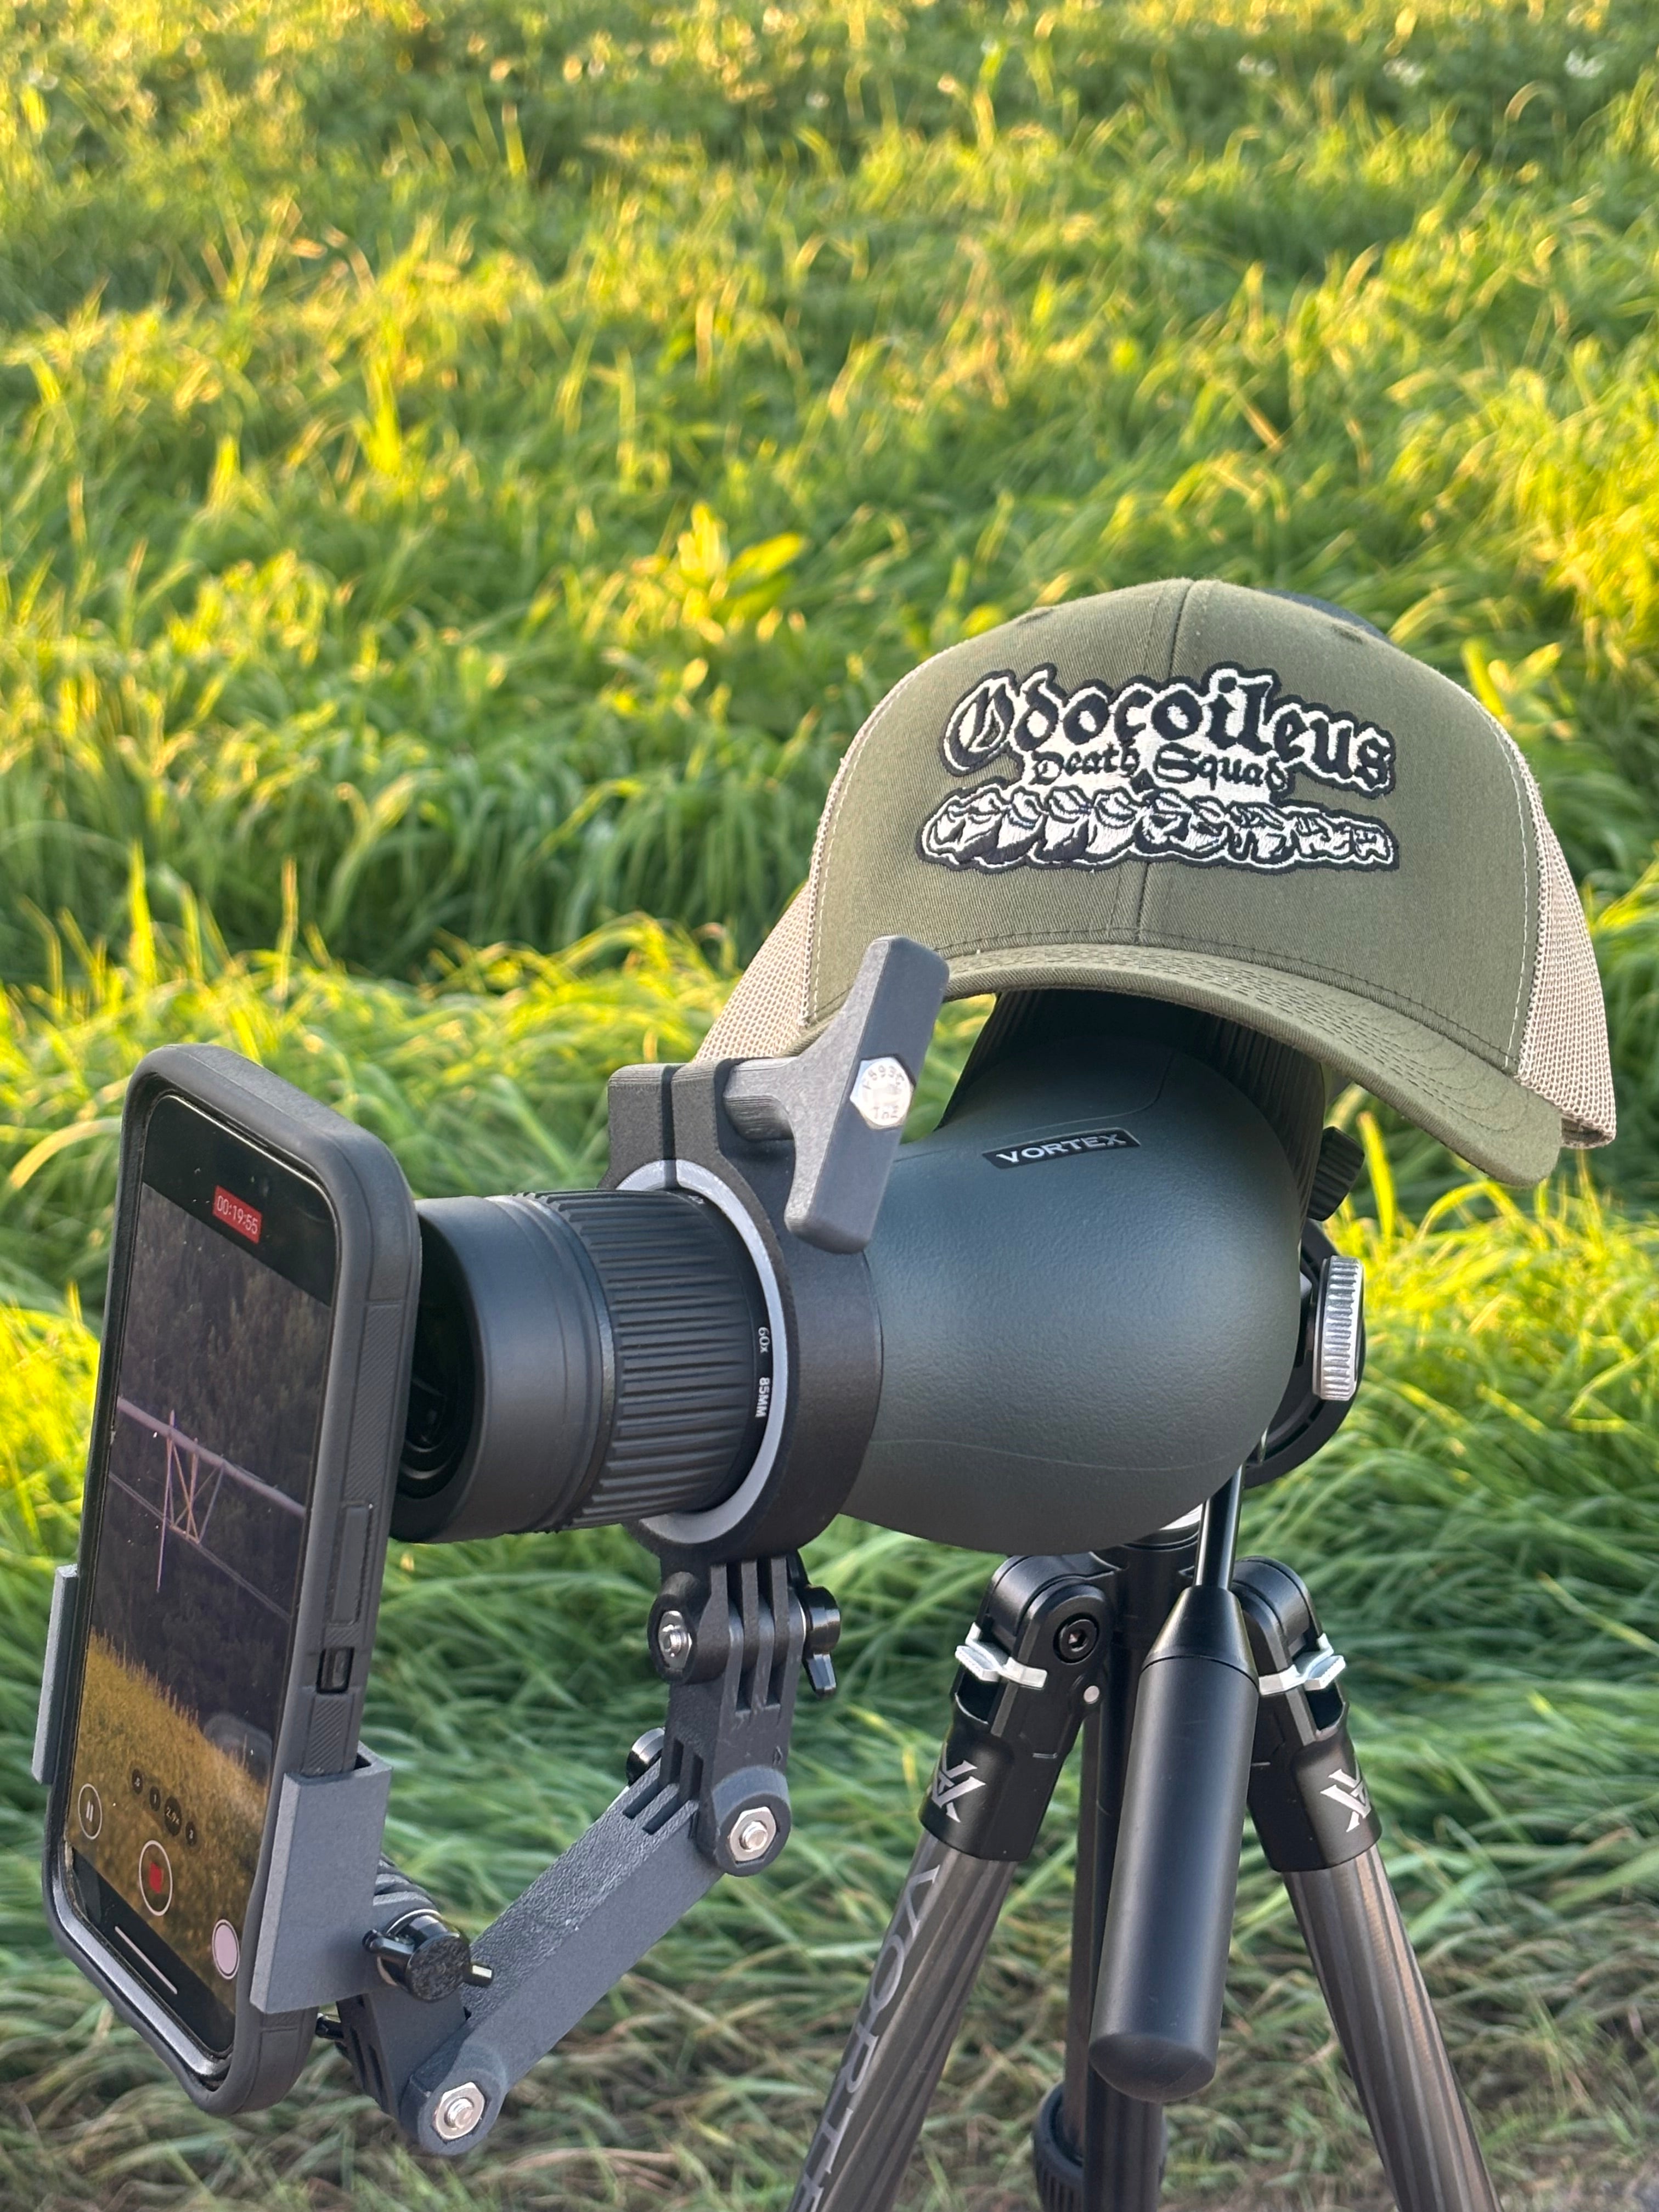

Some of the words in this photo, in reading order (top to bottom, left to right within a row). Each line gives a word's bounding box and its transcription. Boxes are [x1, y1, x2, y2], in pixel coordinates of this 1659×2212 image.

[945, 666, 1396, 791] Odocoileus
[1028, 738, 1140, 786] Death
[1153, 742, 1287, 791] Squad
[996, 1133, 1126, 1163] VORTEX
[217, 1195, 258, 1235] 00:19:55
[758, 1327, 770, 1354] 60x
[755, 1377, 770, 1418] 85MM
